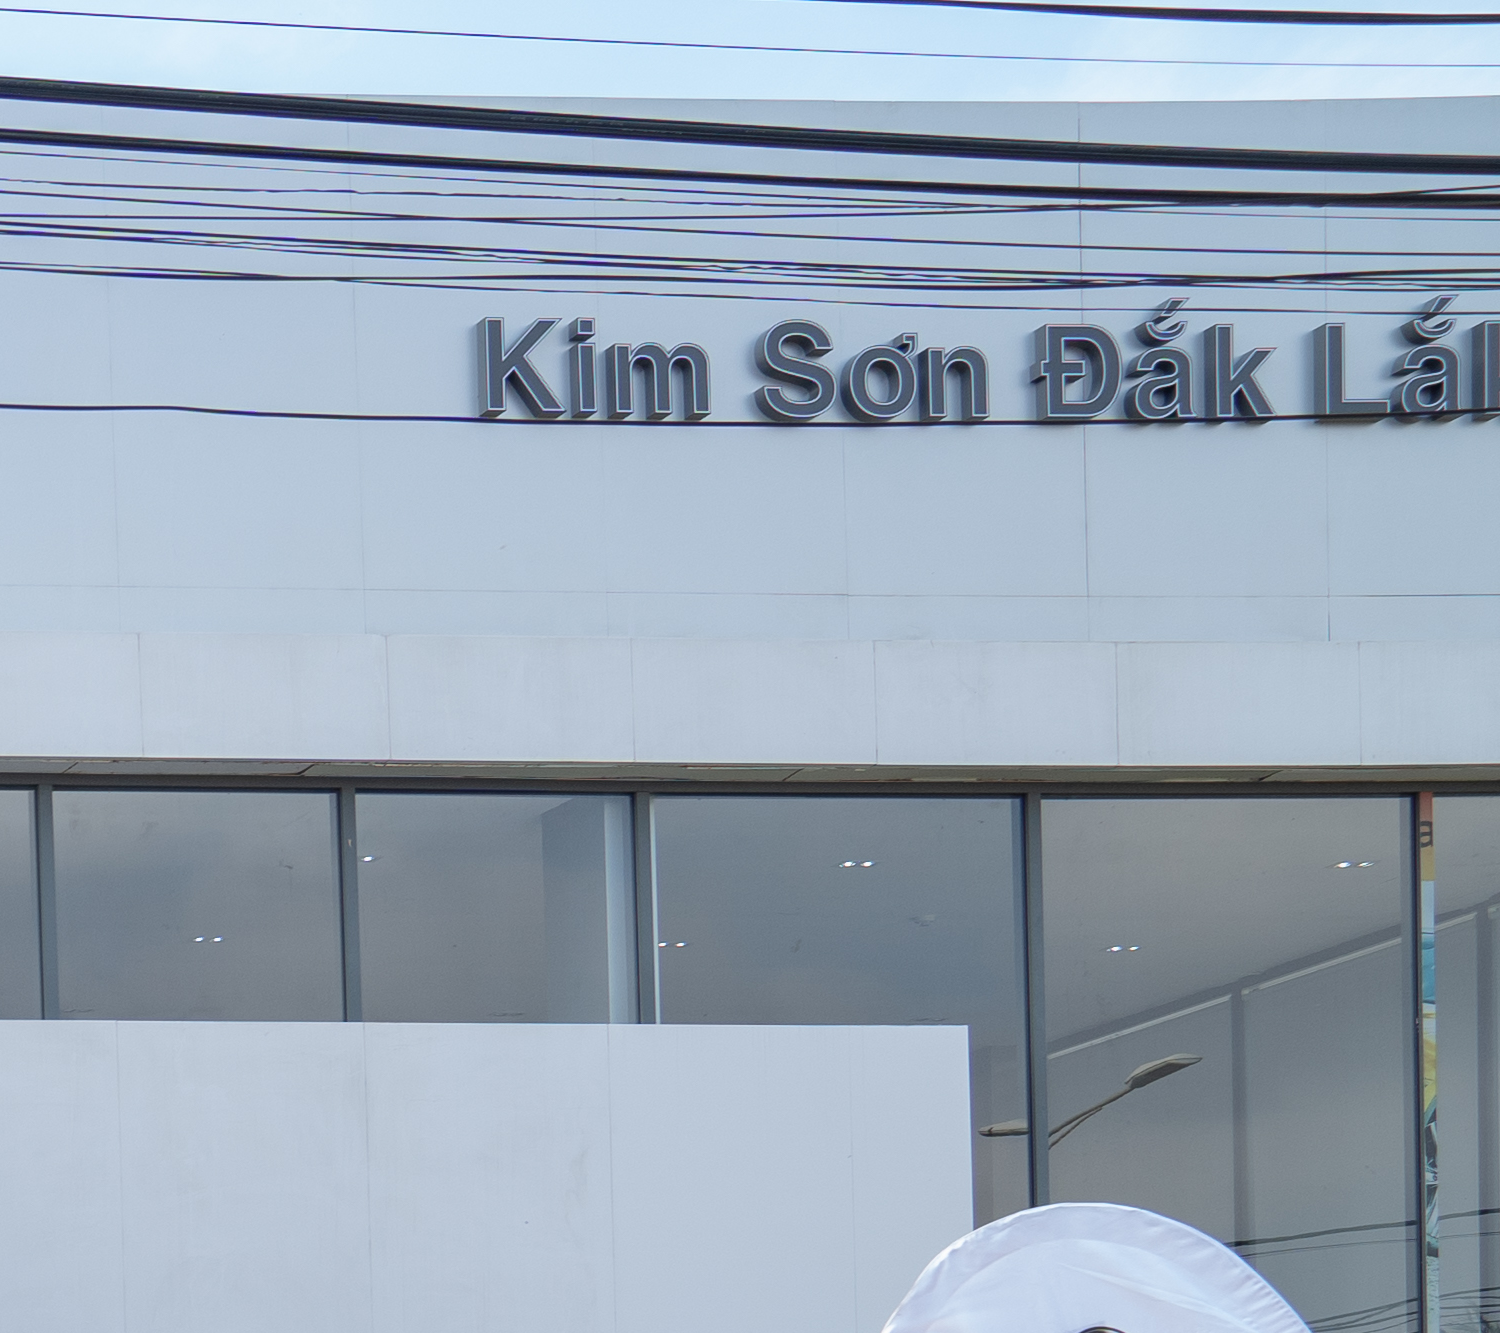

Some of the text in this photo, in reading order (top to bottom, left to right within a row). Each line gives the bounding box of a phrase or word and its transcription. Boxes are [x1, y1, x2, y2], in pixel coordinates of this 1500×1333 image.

[477, 316, 711, 419] Kim
[754, 318, 990, 424] Sơn
[1030, 297, 1277, 424] Đắk
